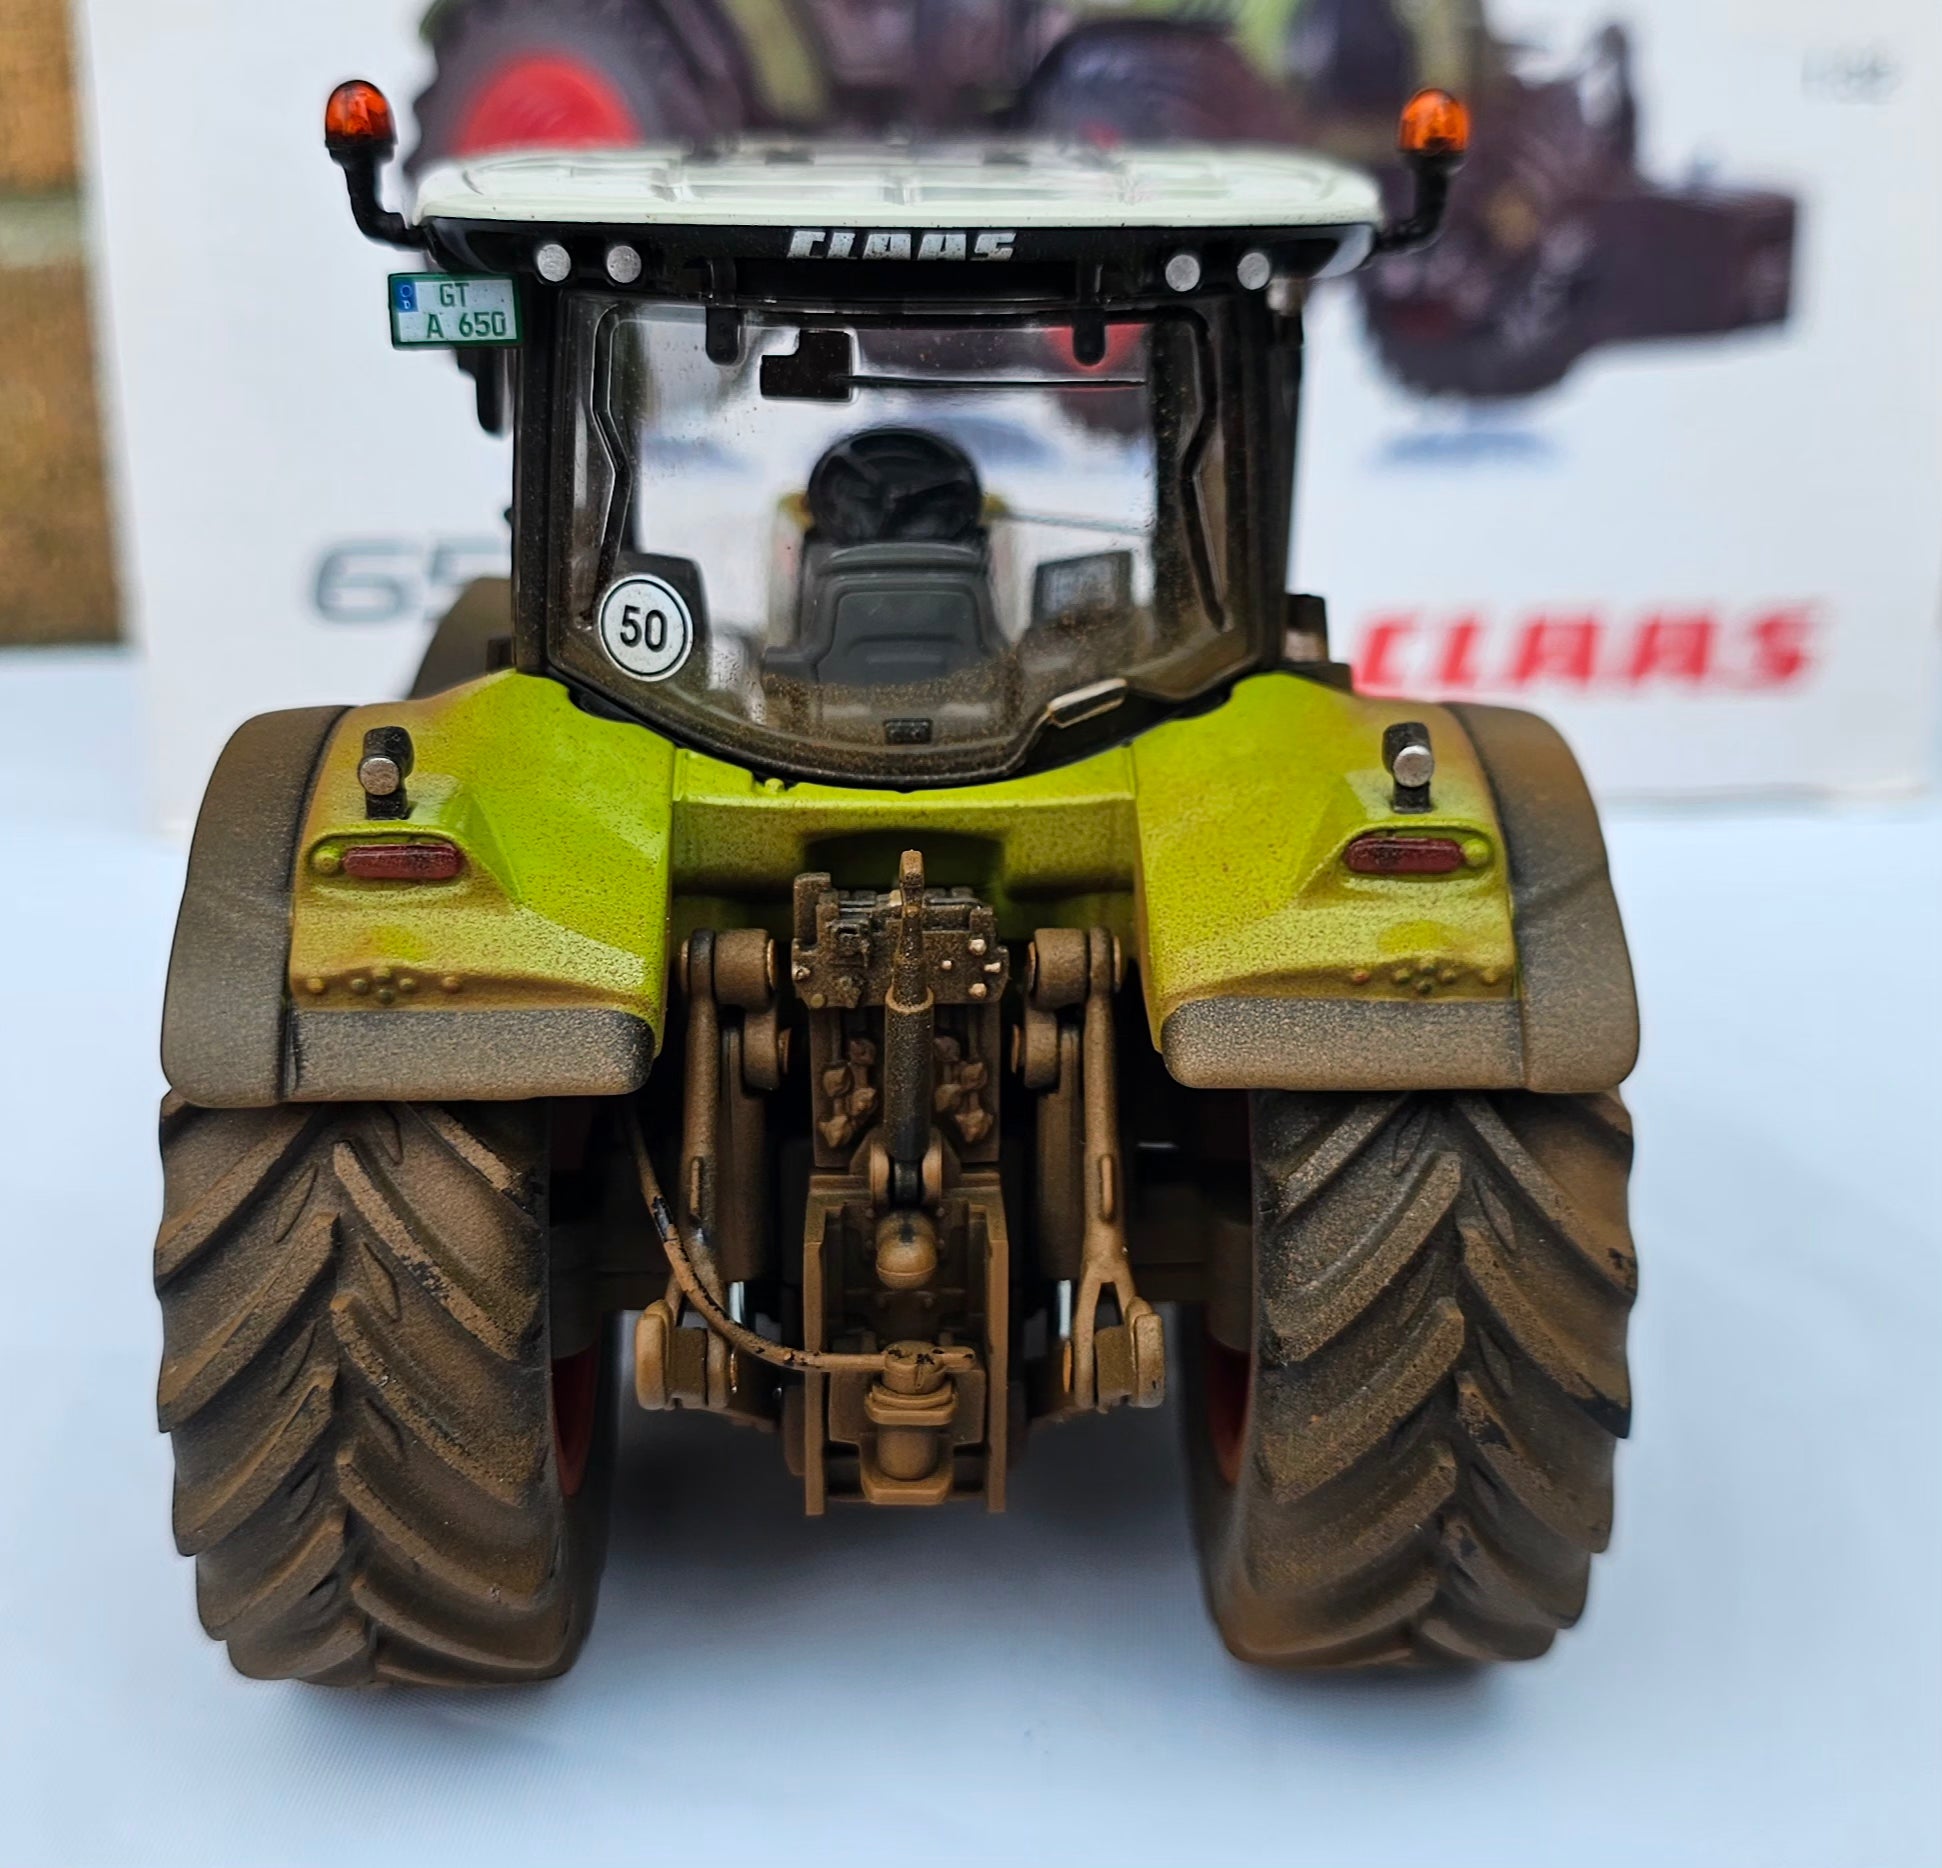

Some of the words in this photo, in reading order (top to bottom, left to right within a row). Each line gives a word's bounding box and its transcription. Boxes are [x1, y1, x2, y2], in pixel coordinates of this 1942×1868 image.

[786, 230, 1017, 262] CLAAS
[439, 282, 470, 308] GT
[426, 312, 444, 339] A
[458, 310, 507, 338] 650
[619, 604, 668, 653] 50
[1358, 604, 1830, 692] CLAAS
